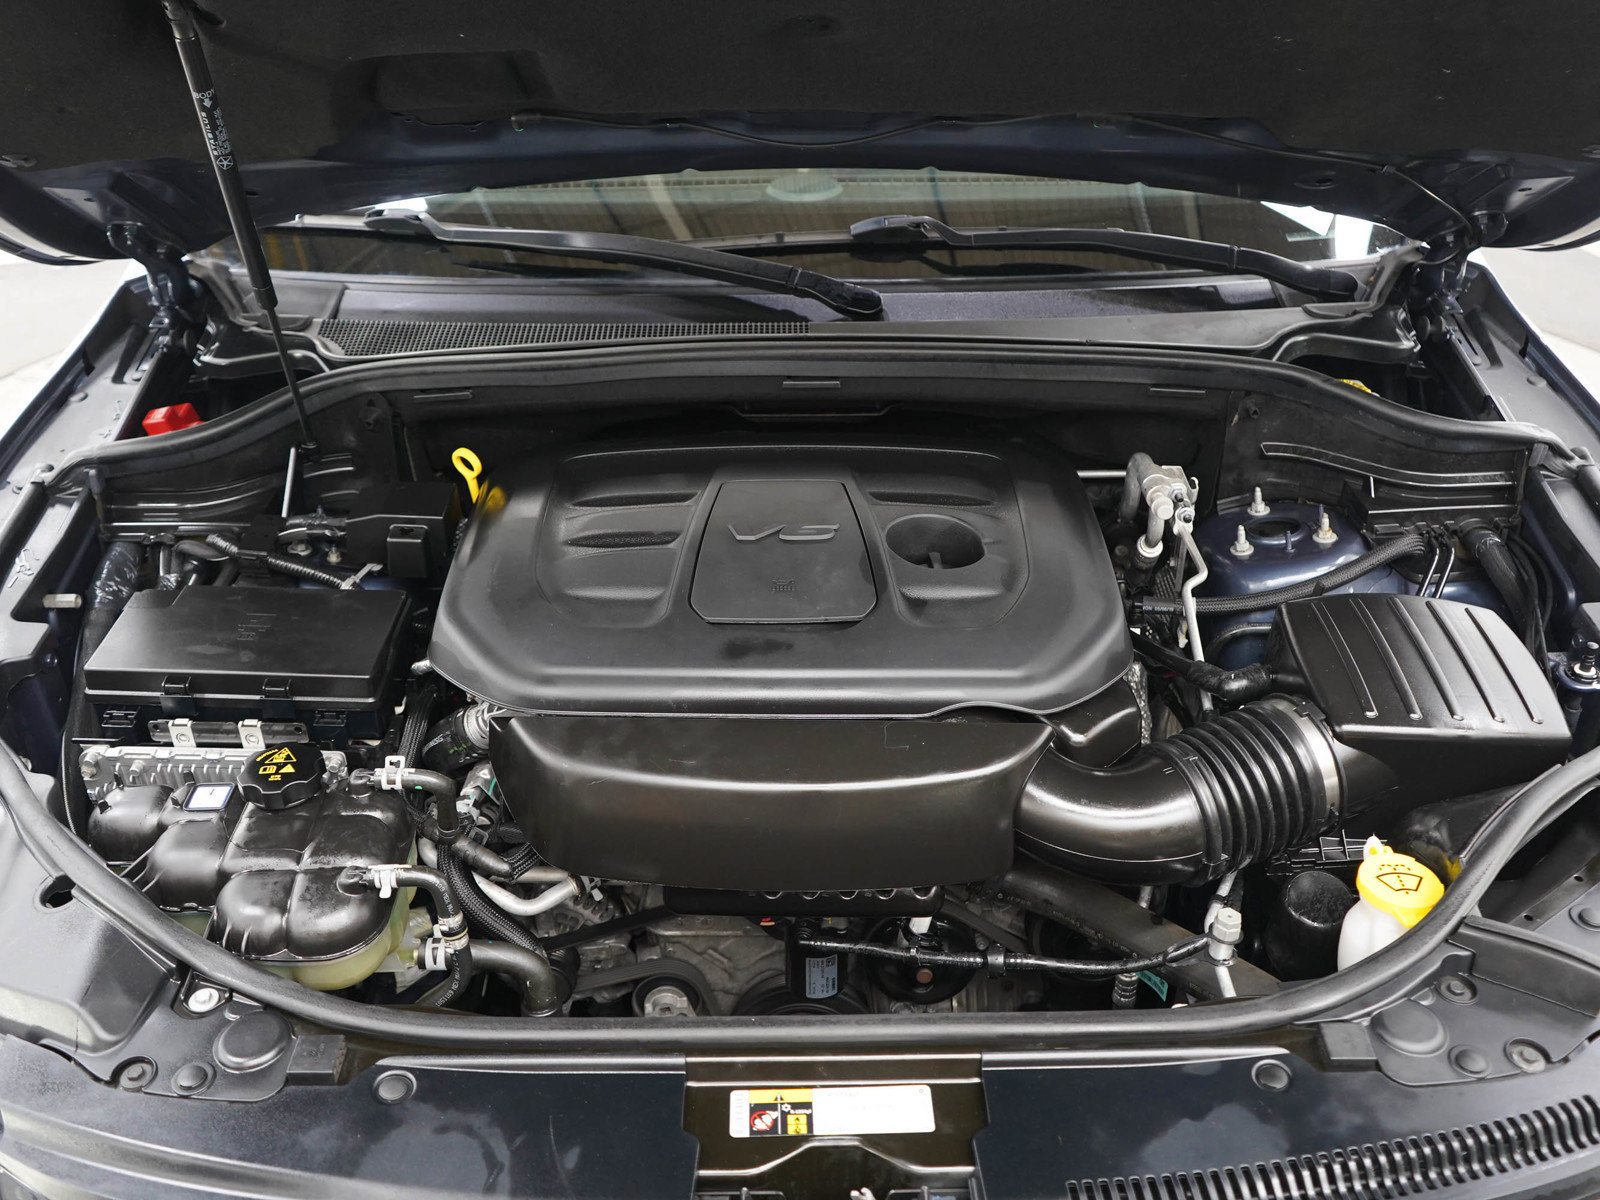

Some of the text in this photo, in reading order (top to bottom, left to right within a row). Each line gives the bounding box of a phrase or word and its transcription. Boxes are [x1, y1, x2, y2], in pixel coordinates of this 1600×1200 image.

[192, 89, 215, 99] BODY
[200, 111, 219, 156] STABILUS
[727, 523, 841, 541] V6
